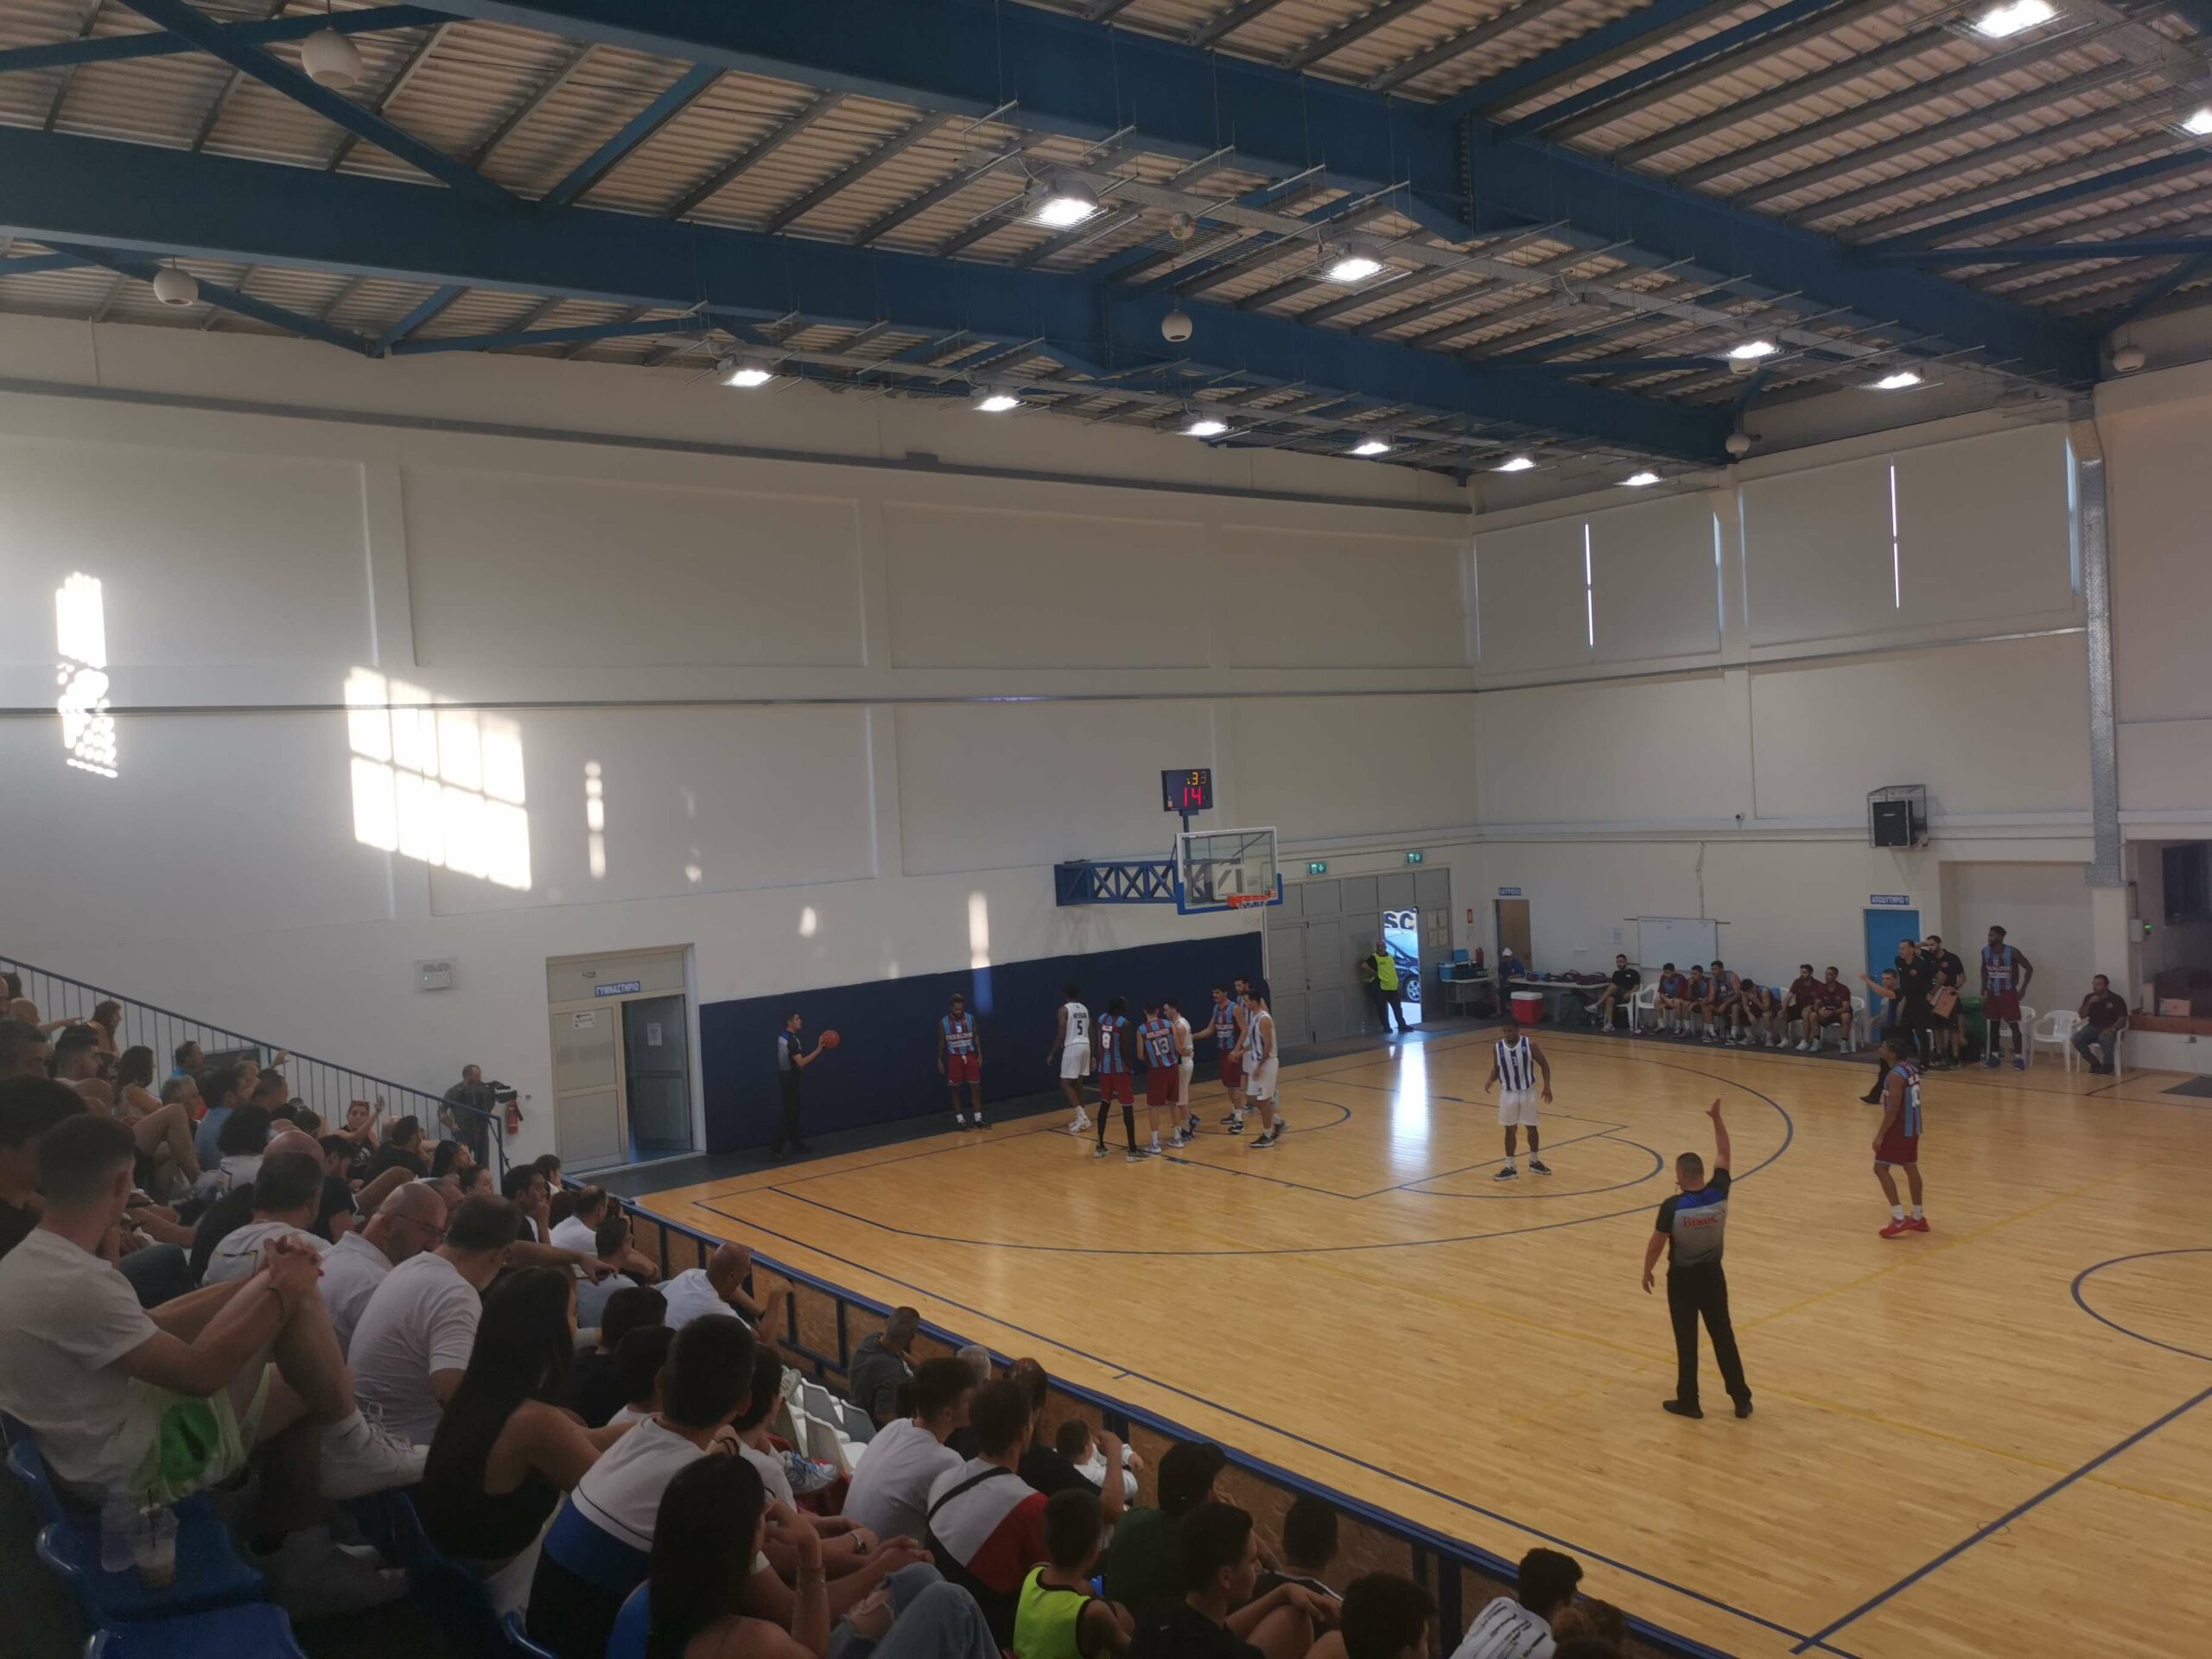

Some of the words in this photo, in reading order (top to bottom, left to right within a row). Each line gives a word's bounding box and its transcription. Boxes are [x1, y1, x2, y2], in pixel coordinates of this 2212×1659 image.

[1184, 787, 1202, 807] 14
[1077, 1020, 1083, 1035] 5
[1102, 1032, 1111, 1049] 8
[1152, 1037, 1170, 1056] 13
[1512, 1056, 1517, 1066] 3
